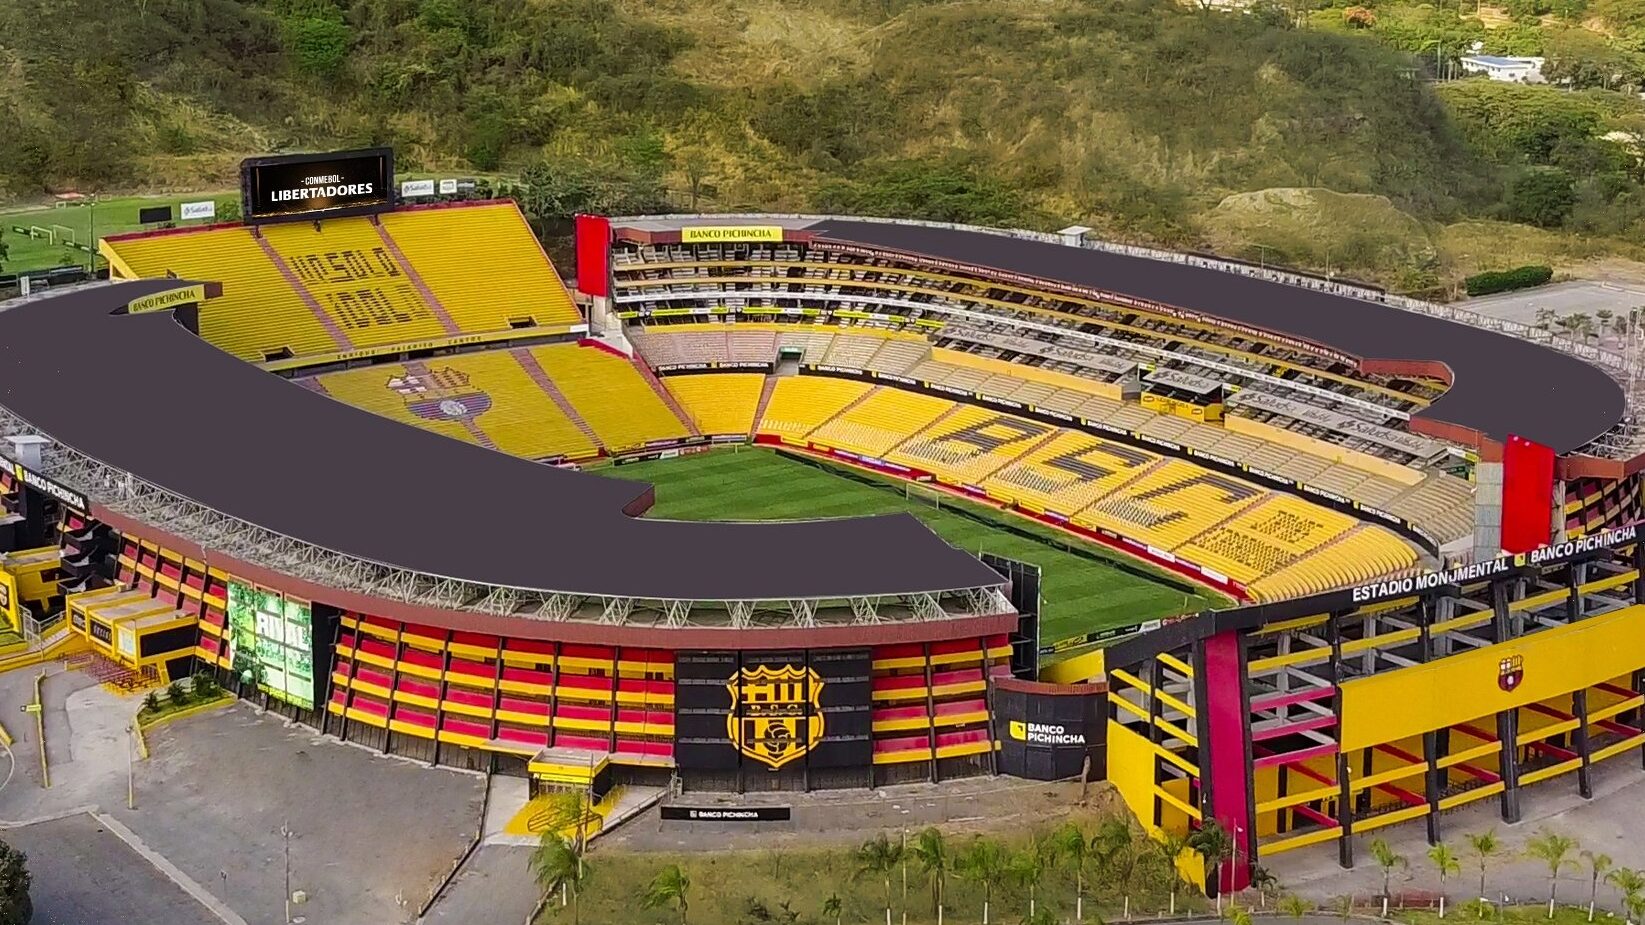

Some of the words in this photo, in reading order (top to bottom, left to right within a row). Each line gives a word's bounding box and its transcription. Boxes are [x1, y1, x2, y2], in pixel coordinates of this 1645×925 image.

[271, 183, 373, 202] LIBERTADORES
[690, 230, 721, 238] BANCO
[722, 229, 772, 238] PICHINCHA
[133, 298, 155, 312] BANCO
[155, 289, 196, 306] PICHINCHA
[1530, 543, 1574, 564] BANCO
[1575, 525, 1637, 556] PICHINCHA
[1352, 578, 1413, 602] ESTADIO
[1027, 722, 1065, 735] BANCO
[1027, 733, 1086, 744] PICHINCHA
